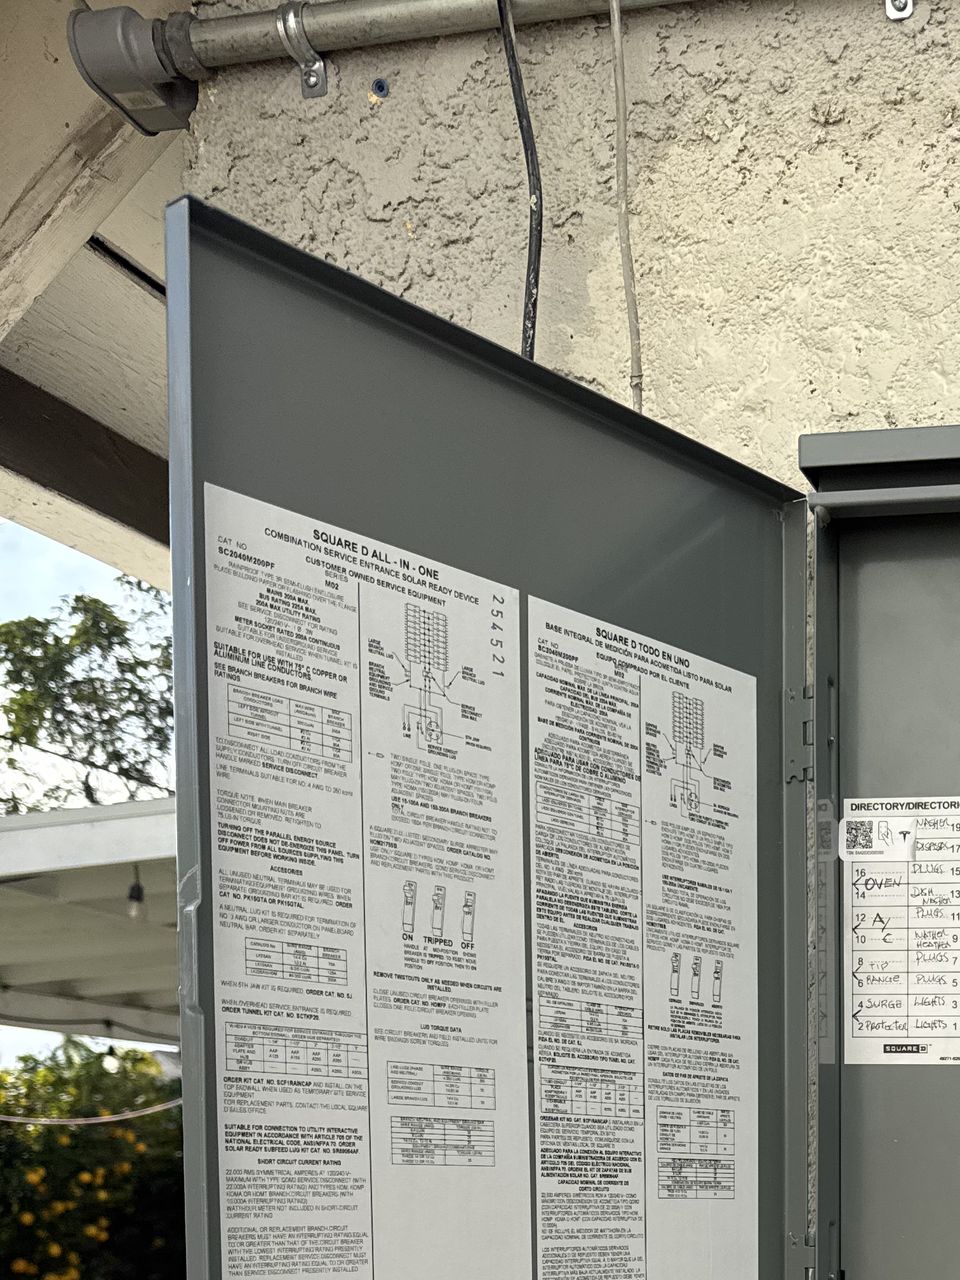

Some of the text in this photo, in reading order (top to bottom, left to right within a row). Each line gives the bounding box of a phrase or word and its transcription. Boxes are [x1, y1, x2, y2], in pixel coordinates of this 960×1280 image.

[217, 546, 276, 570] SC2040M200PF
[313, 529, 358, 554] SQUARE
[361, 546, 369, 556] D
[371, 548, 391, 565] ALL
[399, 558, 410, 571] IN
[418, 565, 440, 581] ONE
[264, 527, 480, 605] COMBINATION SERVICE ENTRANCE SOLAR READY DEVICE
[305, 555, 447, 608] CUSTOMER OWNED SERVICE EQUIPMENT
[324, 570, 349, 583] SERIES
[595, 627, 690, 669] SQUARE D TODO EN UNO
[213, 649, 250, 665] ALUMINUM
[251, 659, 266, 669] LINE
[213, 641, 246, 657] SUITABLE
[247, 650, 262, 661] FOR
[262, 654, 276, 664] USE
[276, 656, 293, 669] WITH
[305, 666, 311, 674] C
[311, 667, 337, 681] COPPER
[338, 674, 348, 683] OR
[545, 621, 733, 694] BASE INTEGRAL DE MEDICIÓN PARA ACOMETIDA LISTO PARA SOLAR
[213, 669, 241, 682] RATINGS
[213, 661, 338, 700] SEE BRANCH BREAKERS FOR BRANCH WIRE
[855, 868, 867, 878] 16
[864, 876, 902, 891] OVEN
[855, 891, 866, 900] 14
[855, 913, 867, 923] 12
[950, 912, 960, 922] 11
[401, 933, 475, 950] ON TRIPPED OFF
[855, 935, 866, 944] 10
[951, 934, 959, 944] 9
[857, 957, 864, 966] 8
[915, 951, 950, 966] PLUGS
[952, 957, 958, 966] 7
[857, 979, 864, 988] 6
[952, 979, 959, 988] 5
[857, 1001, 864, 1009] 4
[951, 1000, 958, 1009] 3
[857, 1022, 864, 1031] 2
[952, 1022, 958, 1031] 1
